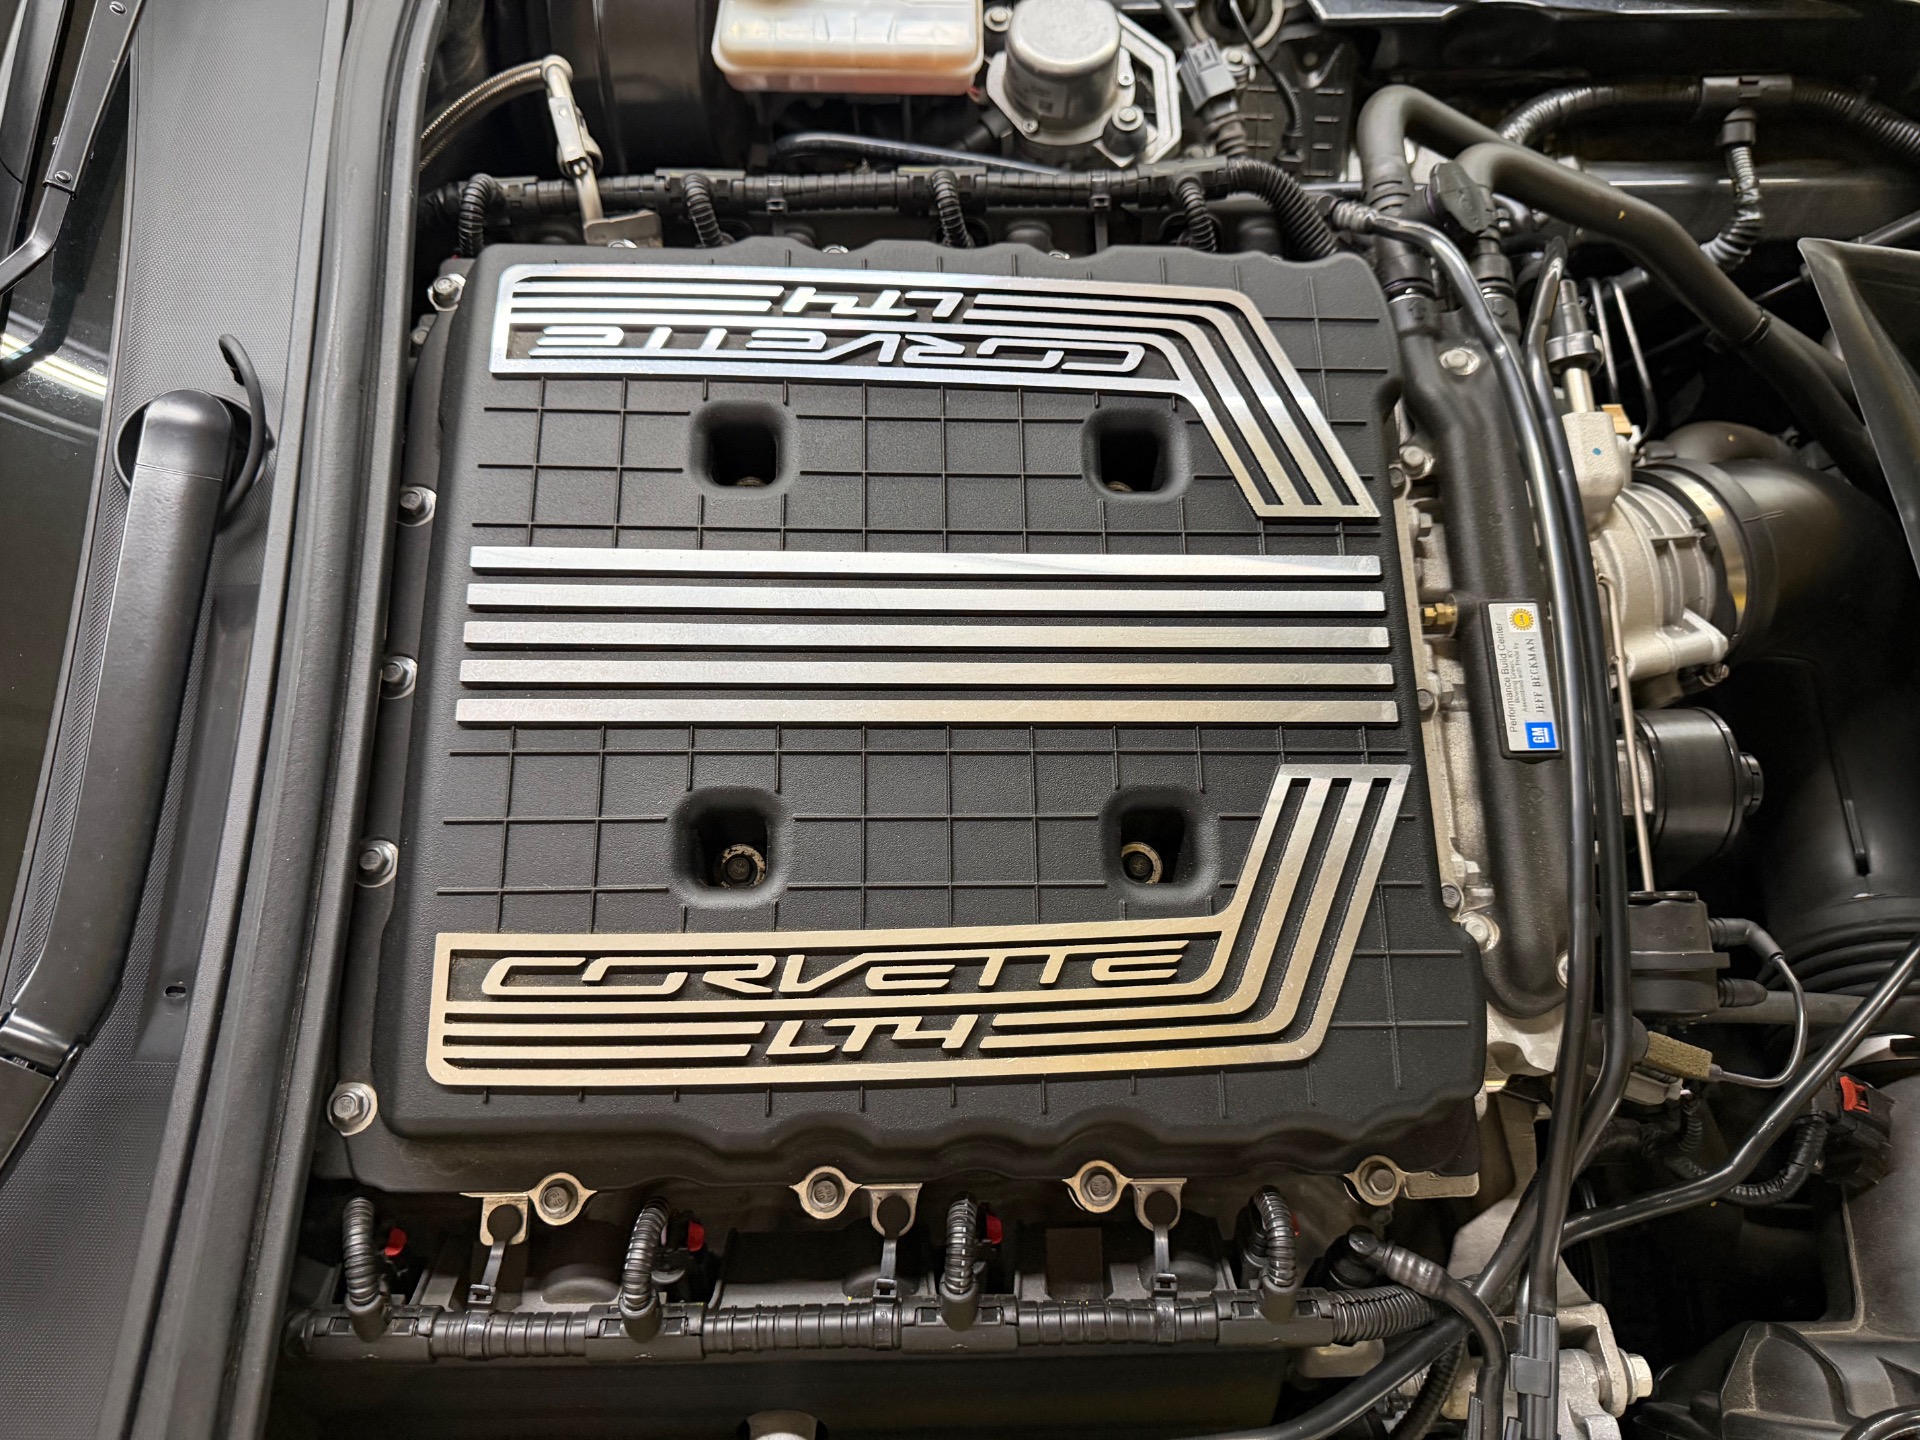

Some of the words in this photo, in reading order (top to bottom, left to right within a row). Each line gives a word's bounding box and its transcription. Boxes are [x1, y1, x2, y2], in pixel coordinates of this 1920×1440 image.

[782, 286, 964, 319] LT4
[528, 326, 1146, 373] CORVETTE
[1496, 622, 1506, 651] Center
[1513, 642, 1520, 650] by
[1499, 653, 1509, 675] Build
[1525, 638, 1542, 687] BECKMAN
[1504, 677, 1518, 733] Performance
[1512, 680, 1520, 704] Bowling
[1519, 680, 1528, 713] Assembled
[1533, 691, 1546, 714] JEFF
[1531, 727, 1546, 744] GM
[482, 940, 1190, 995] CORVETTE
[766, 1014, 979, 1056] LT4
